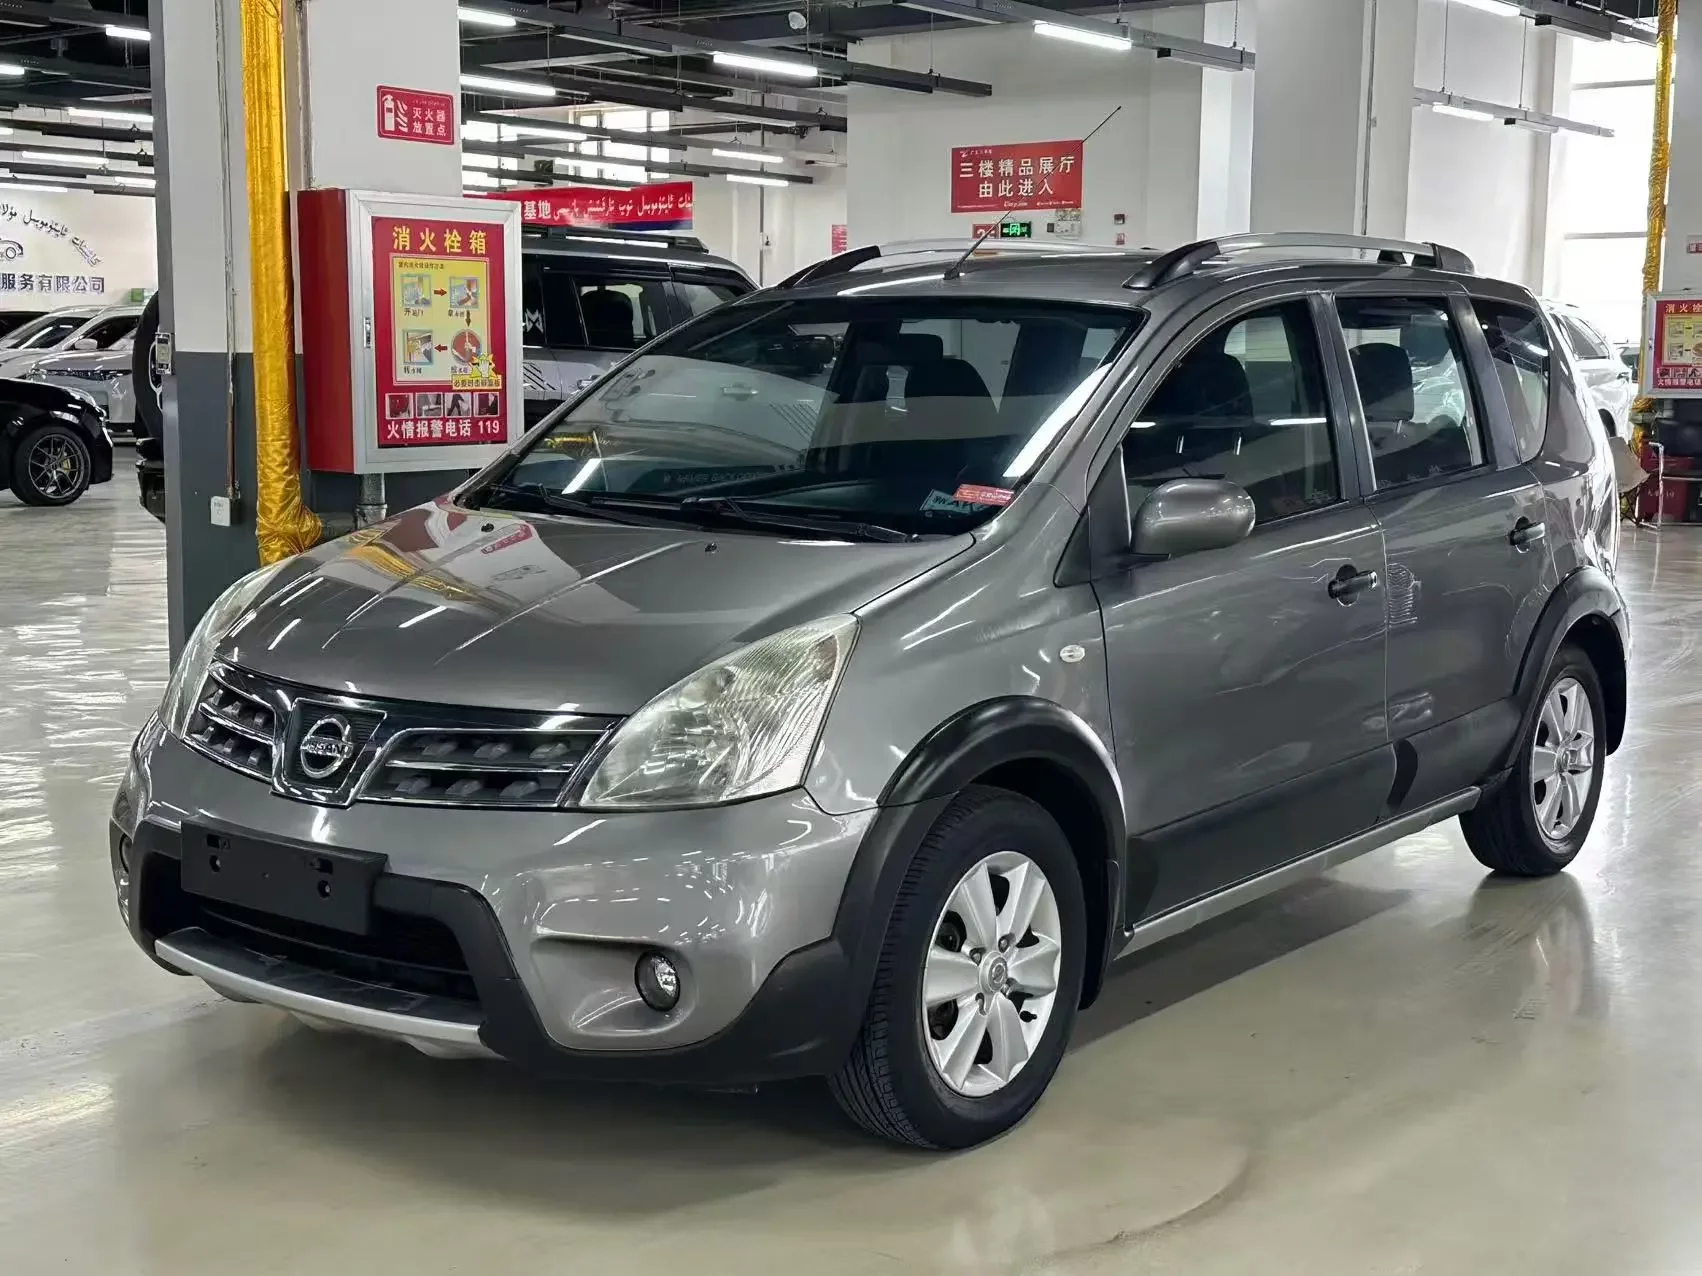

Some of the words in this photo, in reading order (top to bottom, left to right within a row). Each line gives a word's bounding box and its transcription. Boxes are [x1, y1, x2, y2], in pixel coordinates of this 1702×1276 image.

[412, 106, 446, 122] 灭火器
[412, 121, 446, 136] 放置点
[959, 155, 1075, 178] 三楼精品展厅
[978, 178, 1054, 198] 由此进入
[524, 199, 551, 220] 基地
[392, 225, 487, 255] 消火栓箱
[0, 272, 105, 294] 服务有限公司
[387, 419, 472, 439] 火情报警电话
[478, 420, 500, 434] 119
